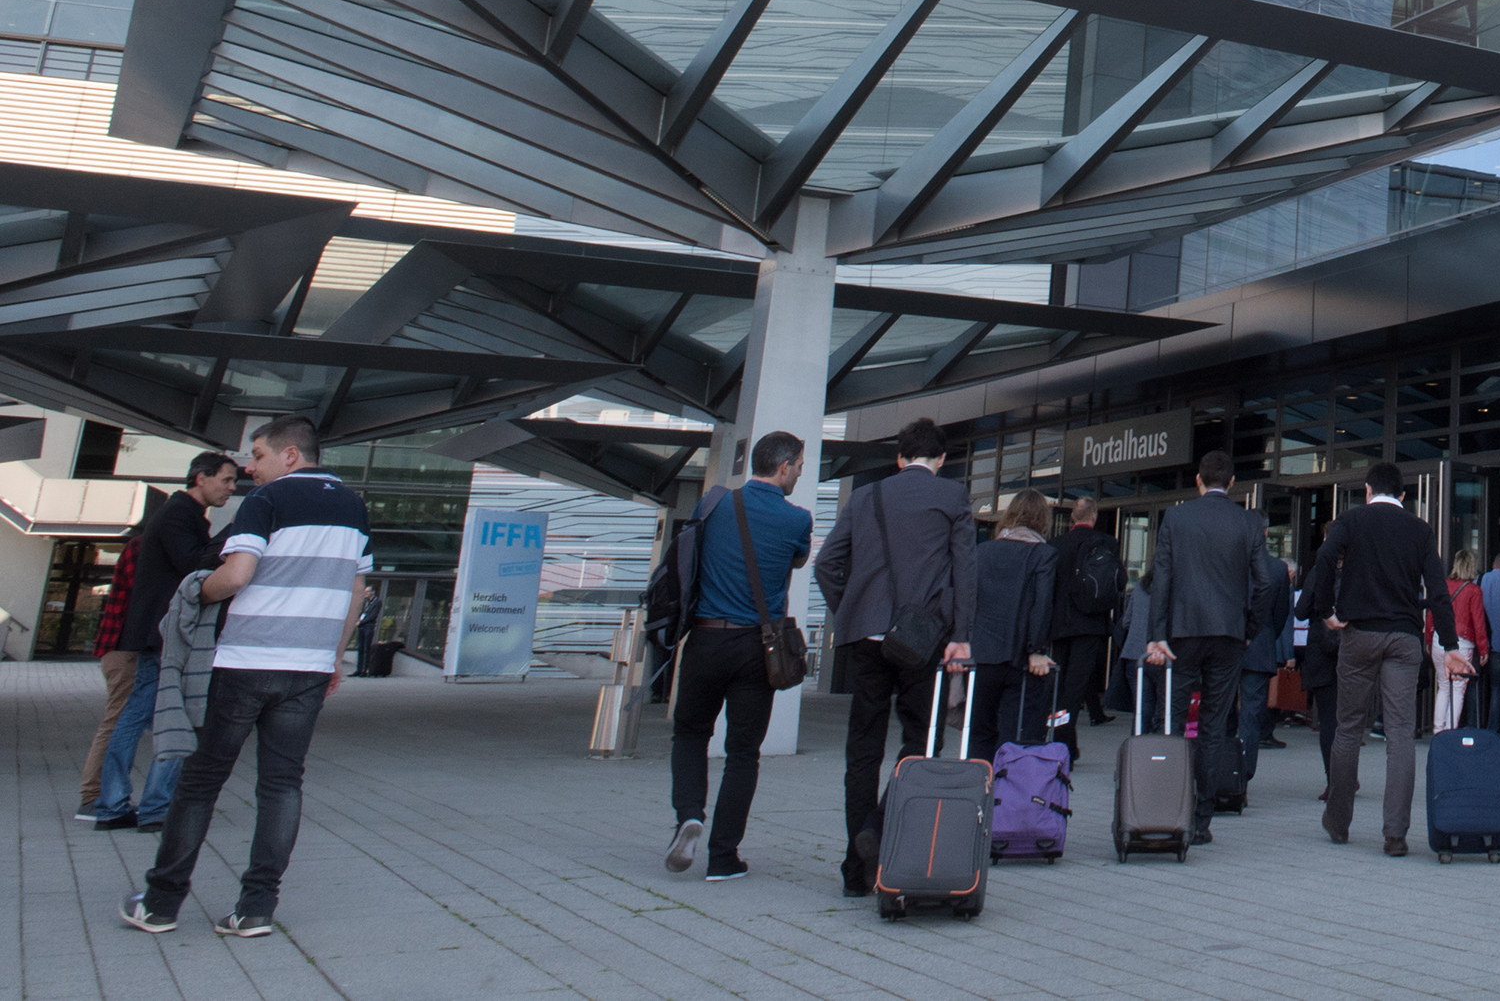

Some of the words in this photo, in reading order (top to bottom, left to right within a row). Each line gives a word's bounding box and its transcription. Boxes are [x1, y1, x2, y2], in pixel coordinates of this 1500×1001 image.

[1082, 428, 1168, 467] Portalhaus
[481, 521, 542, 549] IFFA
[472, 592, 508, 603] Herzlich
[471, 605, 526, 615] willkommen!
[469, 623, 510, 634] Welcome!
